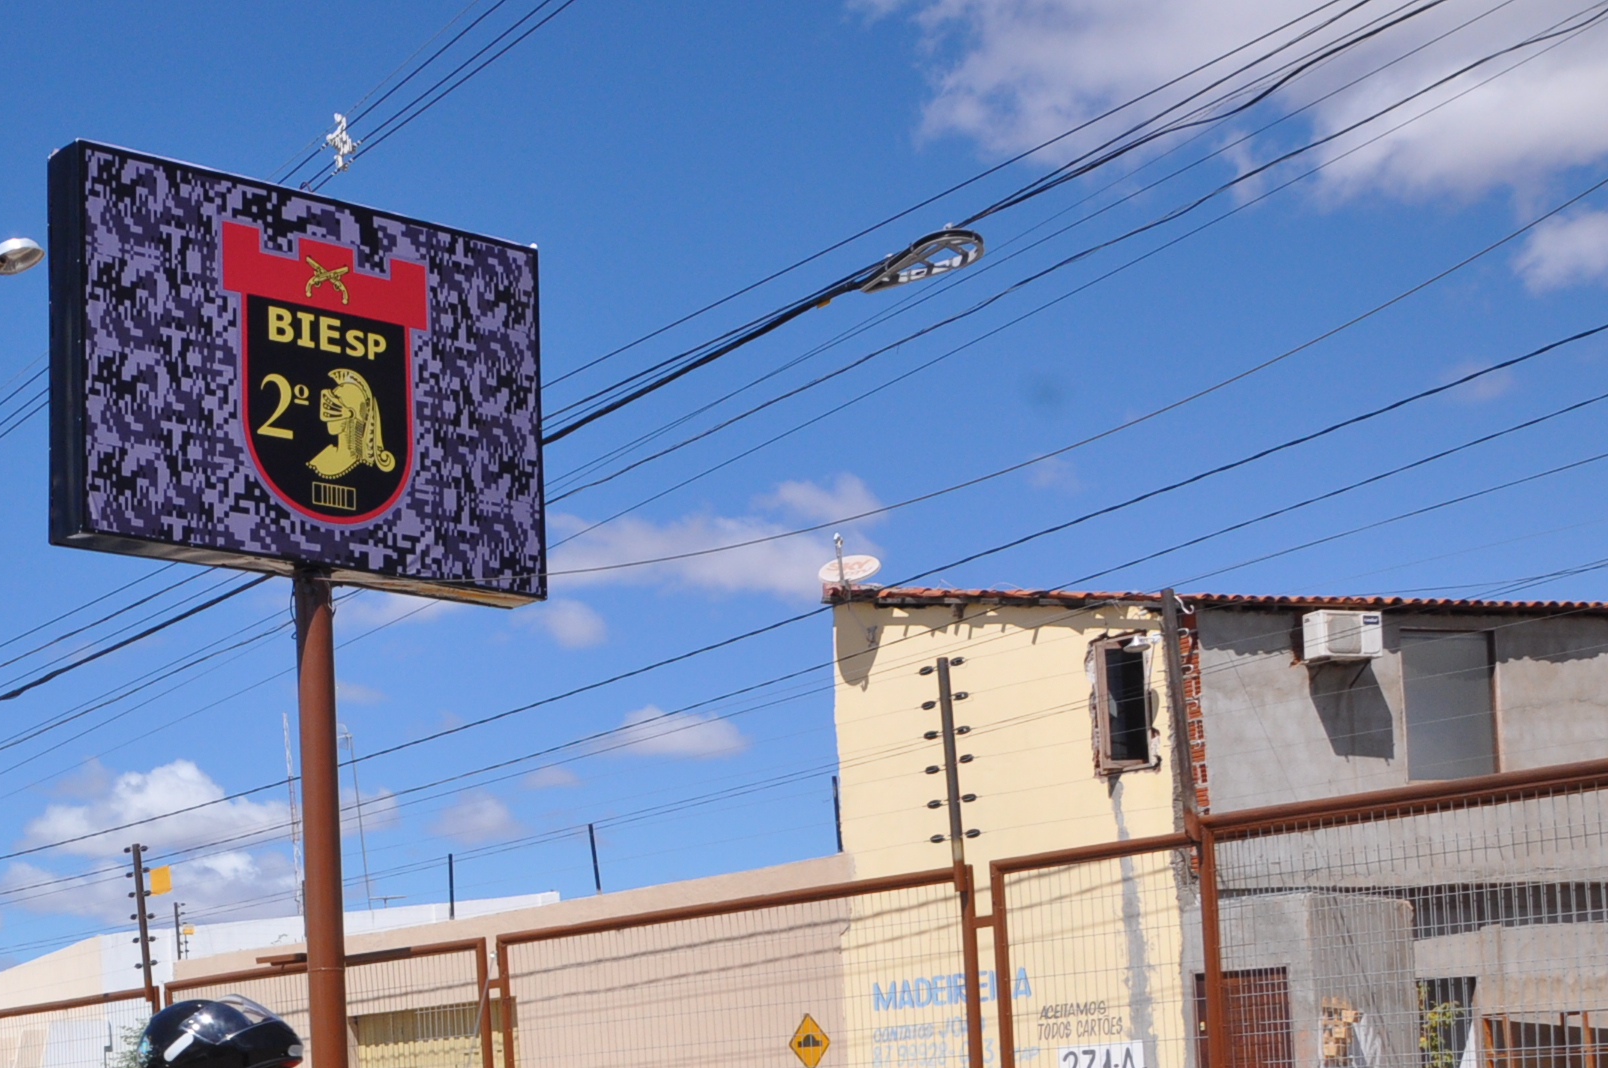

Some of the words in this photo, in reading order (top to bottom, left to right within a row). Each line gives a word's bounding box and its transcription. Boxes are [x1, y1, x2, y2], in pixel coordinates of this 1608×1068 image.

[873, 967, 1031, 1011] MADEIREIA
[1040, 1000, 1106, 1019] ACEITAMOS
[1038, 1021, 1072, 1040] TODOS
[1077, 1015, 1123, 1038] CARTÕES
